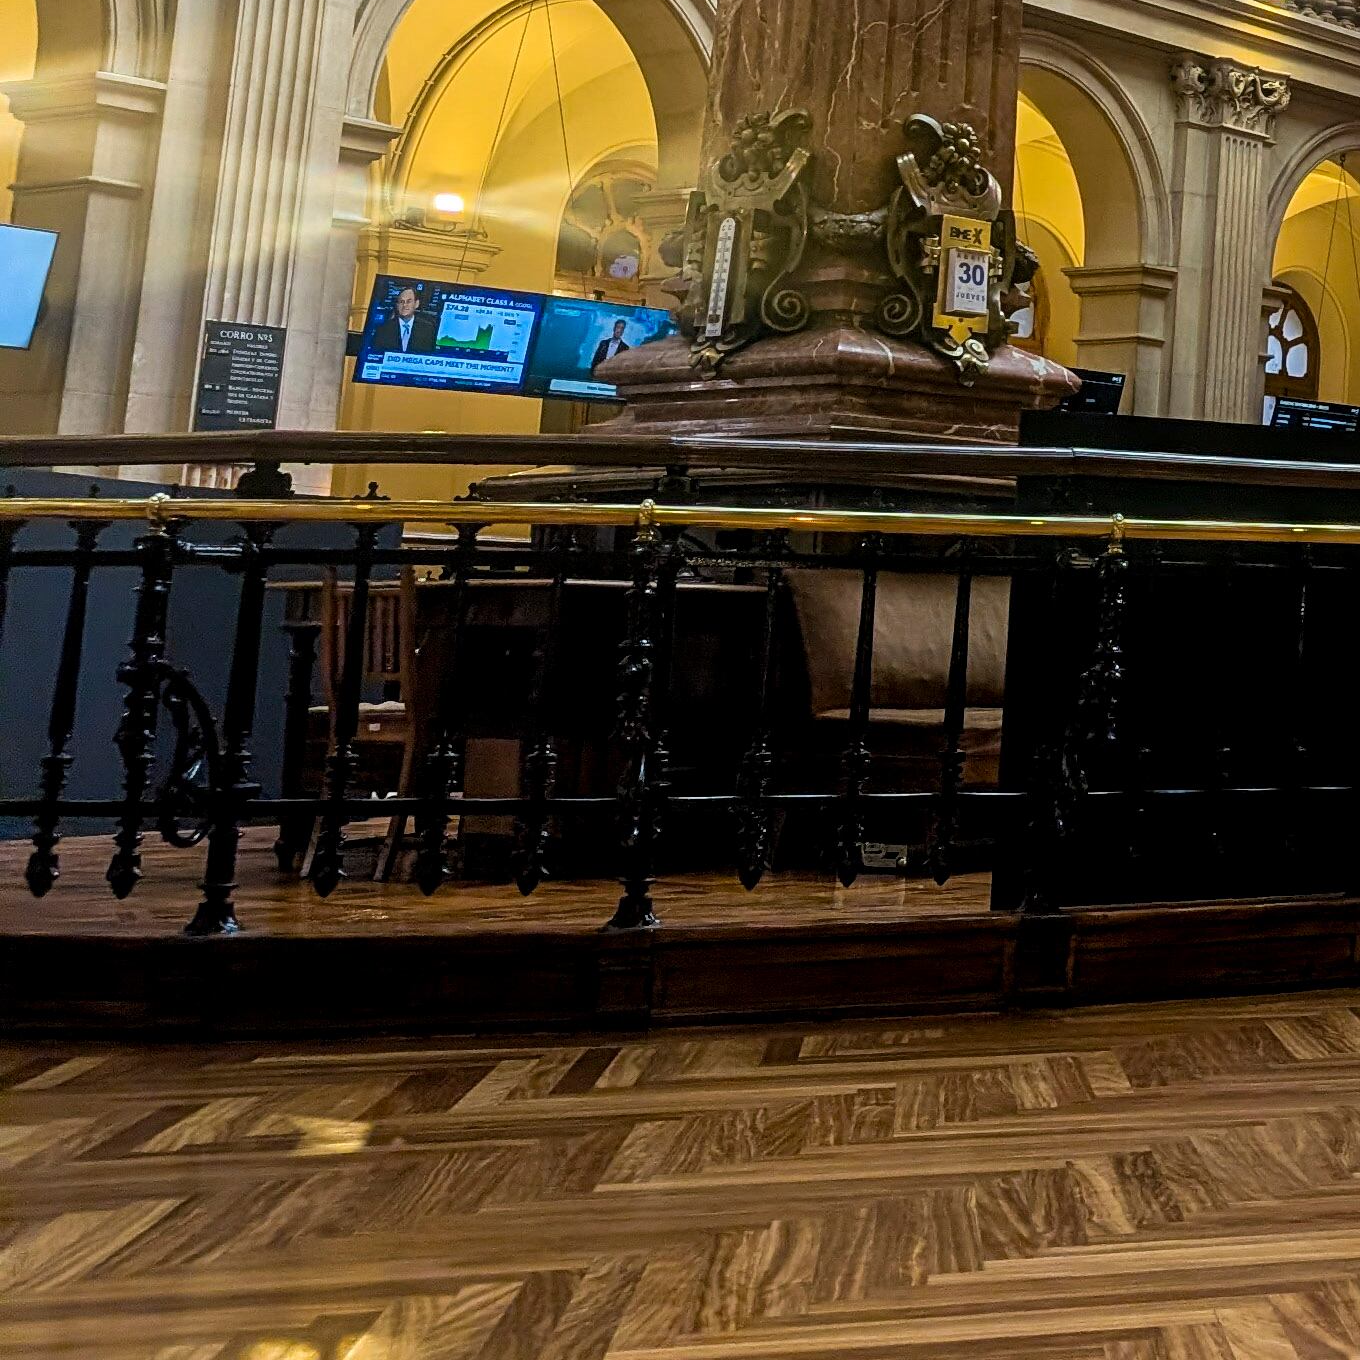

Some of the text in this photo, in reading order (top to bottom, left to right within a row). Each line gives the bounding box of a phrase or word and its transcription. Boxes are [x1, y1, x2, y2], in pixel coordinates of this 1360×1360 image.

[958, 261, 985, 286] 30
[486, 297, 509, 306] CLASS
[955, 291, 986, 302] JUEVES
[219, 330, 254, 341] CORRO
[402, 356, 424, 365] MEGA
[424, 359, 444, 367] CAPS
